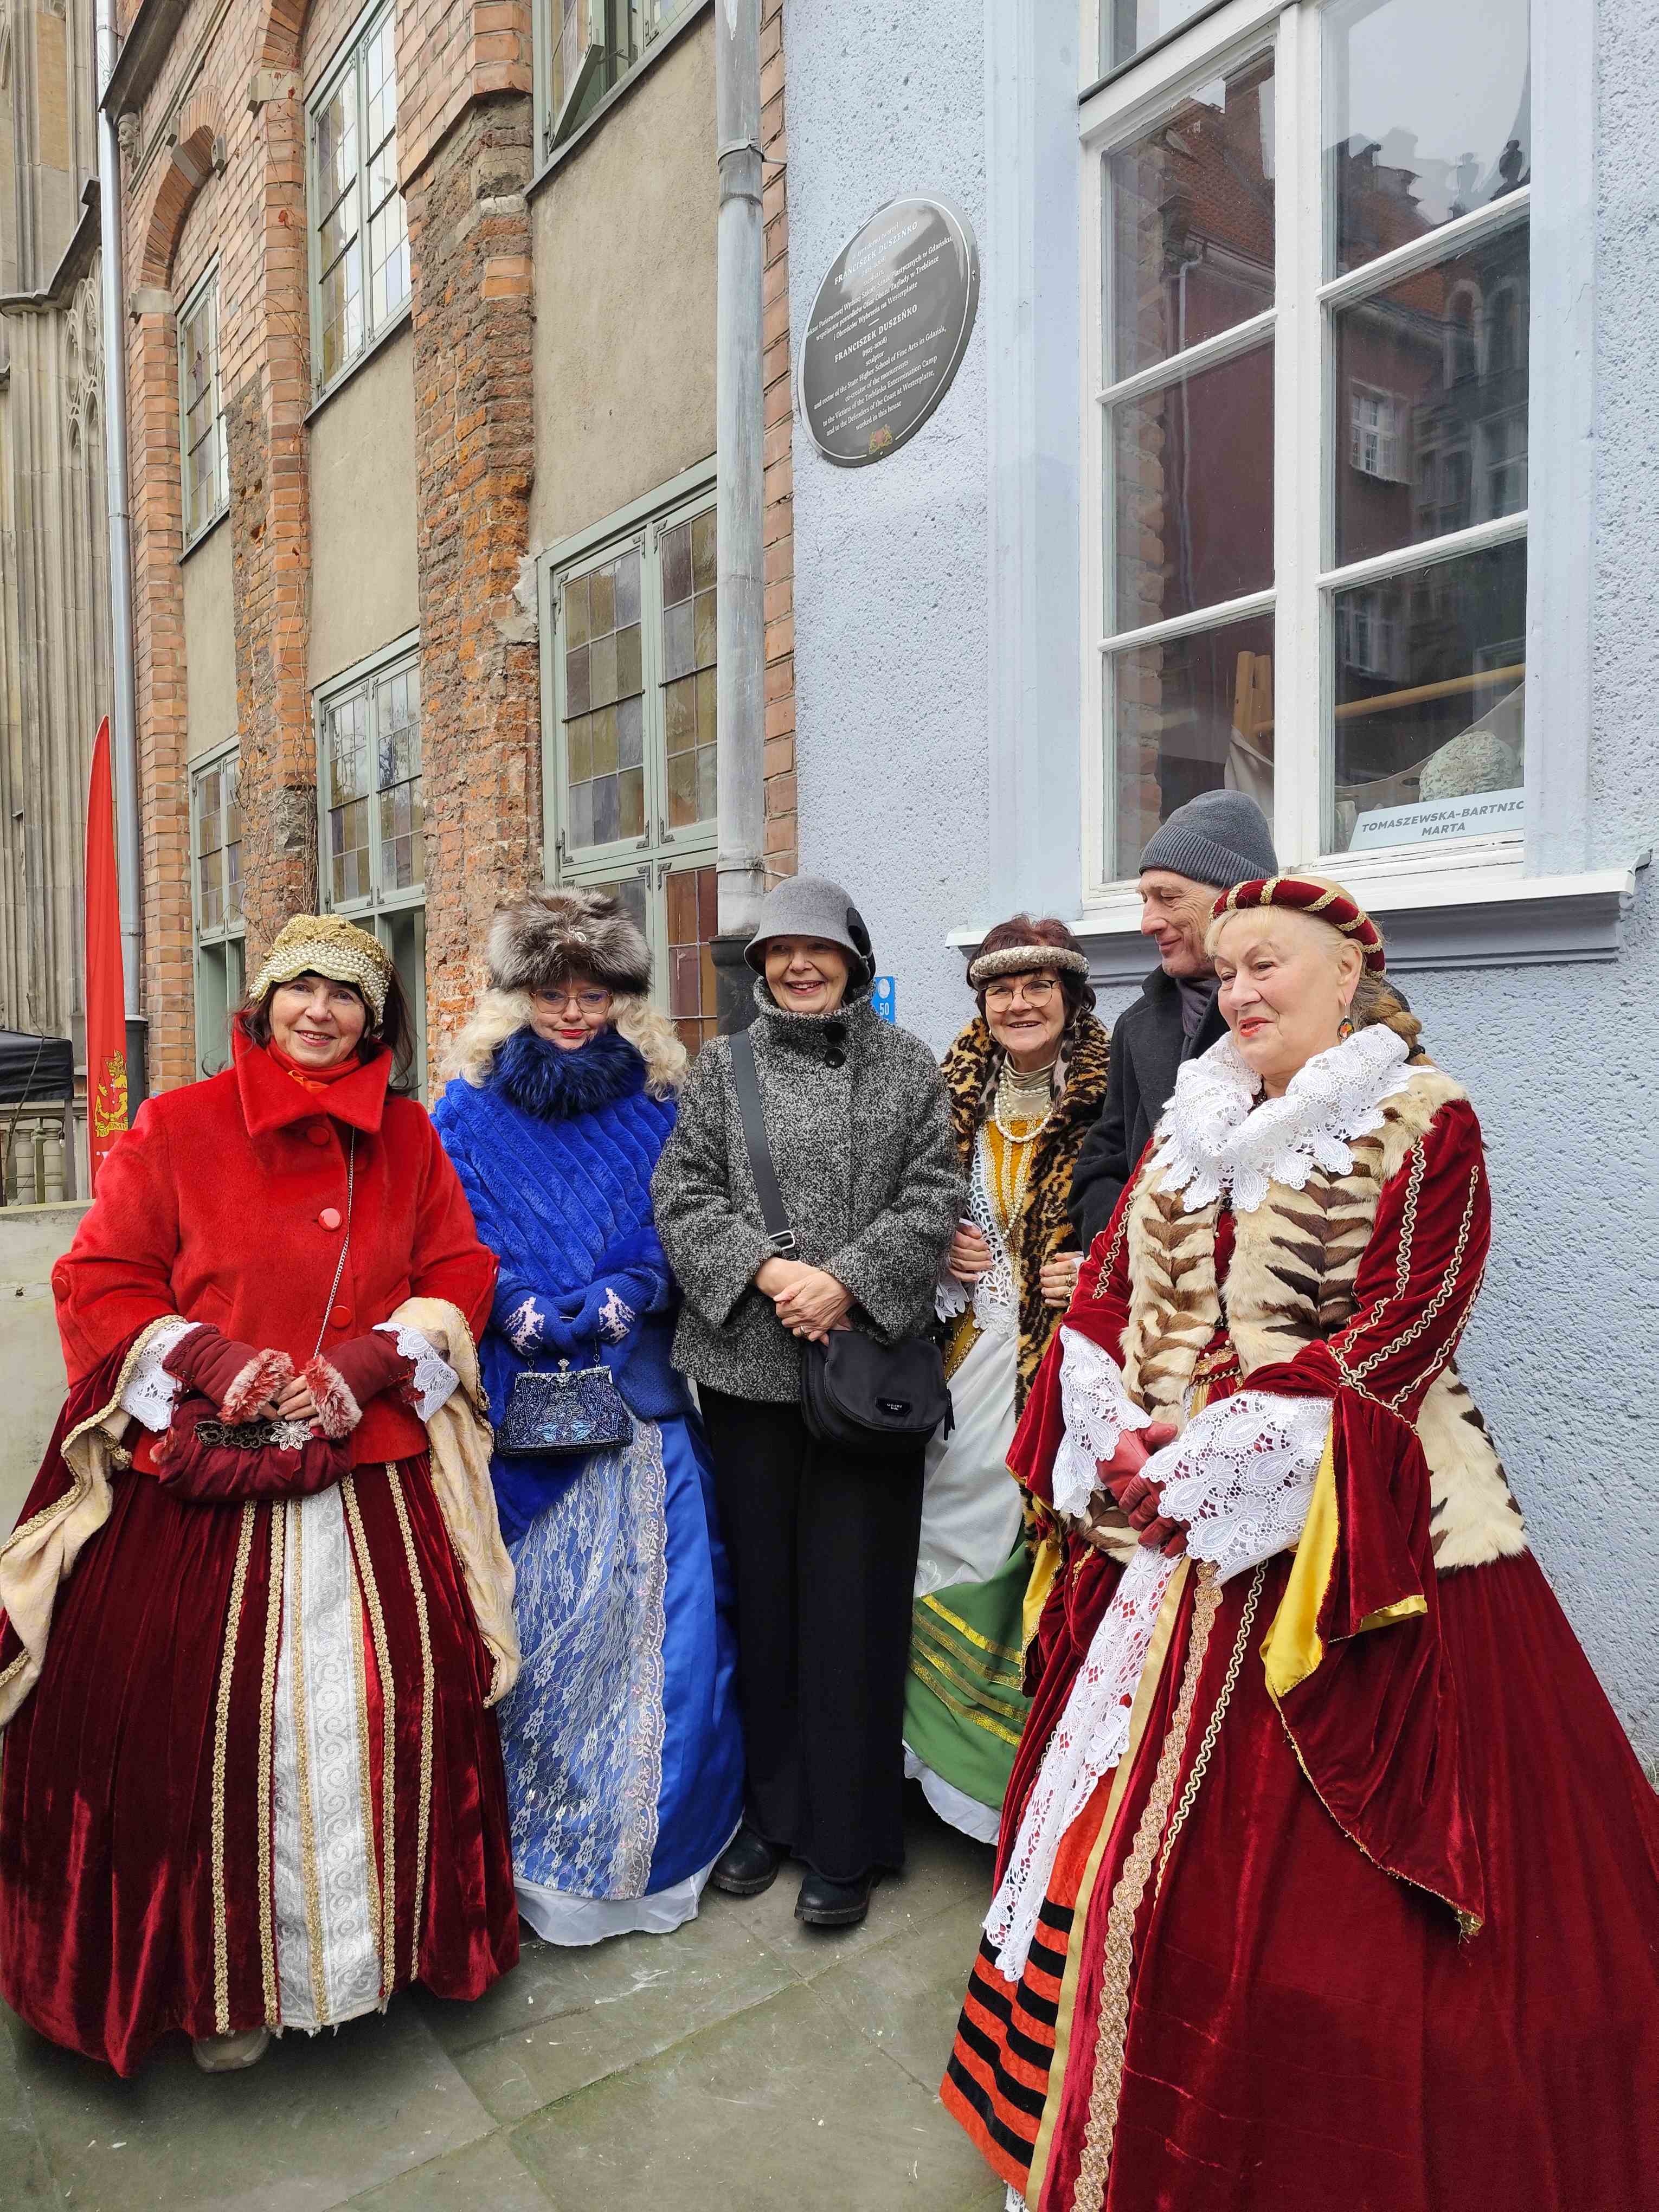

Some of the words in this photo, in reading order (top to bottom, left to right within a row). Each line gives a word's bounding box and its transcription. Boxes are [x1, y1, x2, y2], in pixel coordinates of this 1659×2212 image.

[834, 249, 876, 285] FRANCISZEK
[891, 254, 922, 279] Plastycznych
[928, 237, 953, 254] Gdańsku,
[915, 256, 939, 273] Treblince
[888, 282, 918, 304] Westerplatte
[834, 330, 876, 363] FRANCISZEK
[878, 304, 917, 335] DUSZEŃKO
[814, 399, 822, 410] and
[822, 393, 834, 404] rector
[834, 387, 840, 396] of
[847, 378, 858, 389] State
[859, 368, 874, 382] Higher
[875, 357, 890, 372] School
[891, 352, 896, 362] of
[897, 349, 907, 359] Fine
[908, 342, 918, 352] Arts
[925, 325, 946, 341] Gdańsk,
[865, 351, 884, 366] sculptor
[835, 406, 851, 419] Victims
[852, 400, 857, 409] of
[865, 385, 886, 401] Treblinka
[887, 365, 921, 388] Extermination
[922, 356, 937, 368] Camp
[845, 385, 867, 402] co-creator
[867, 380, 872, 388] of
[880, 360, 909, 381] monuments
[826, 426, 835, 436] and
[848, 407, 870, 423] Defenders
[870, 401, 875, 410] of
[884, 391, 897, 402] Coast
[902, 370, 935, 391] Westerplatte,
[856, 416, 872, 430] worked
[878, 408, 888, 417] this
[888, 401, 902, 411] house
[1422, 822, 1466, 837] MARTA
[879, 1002, 890, 1015] 50
